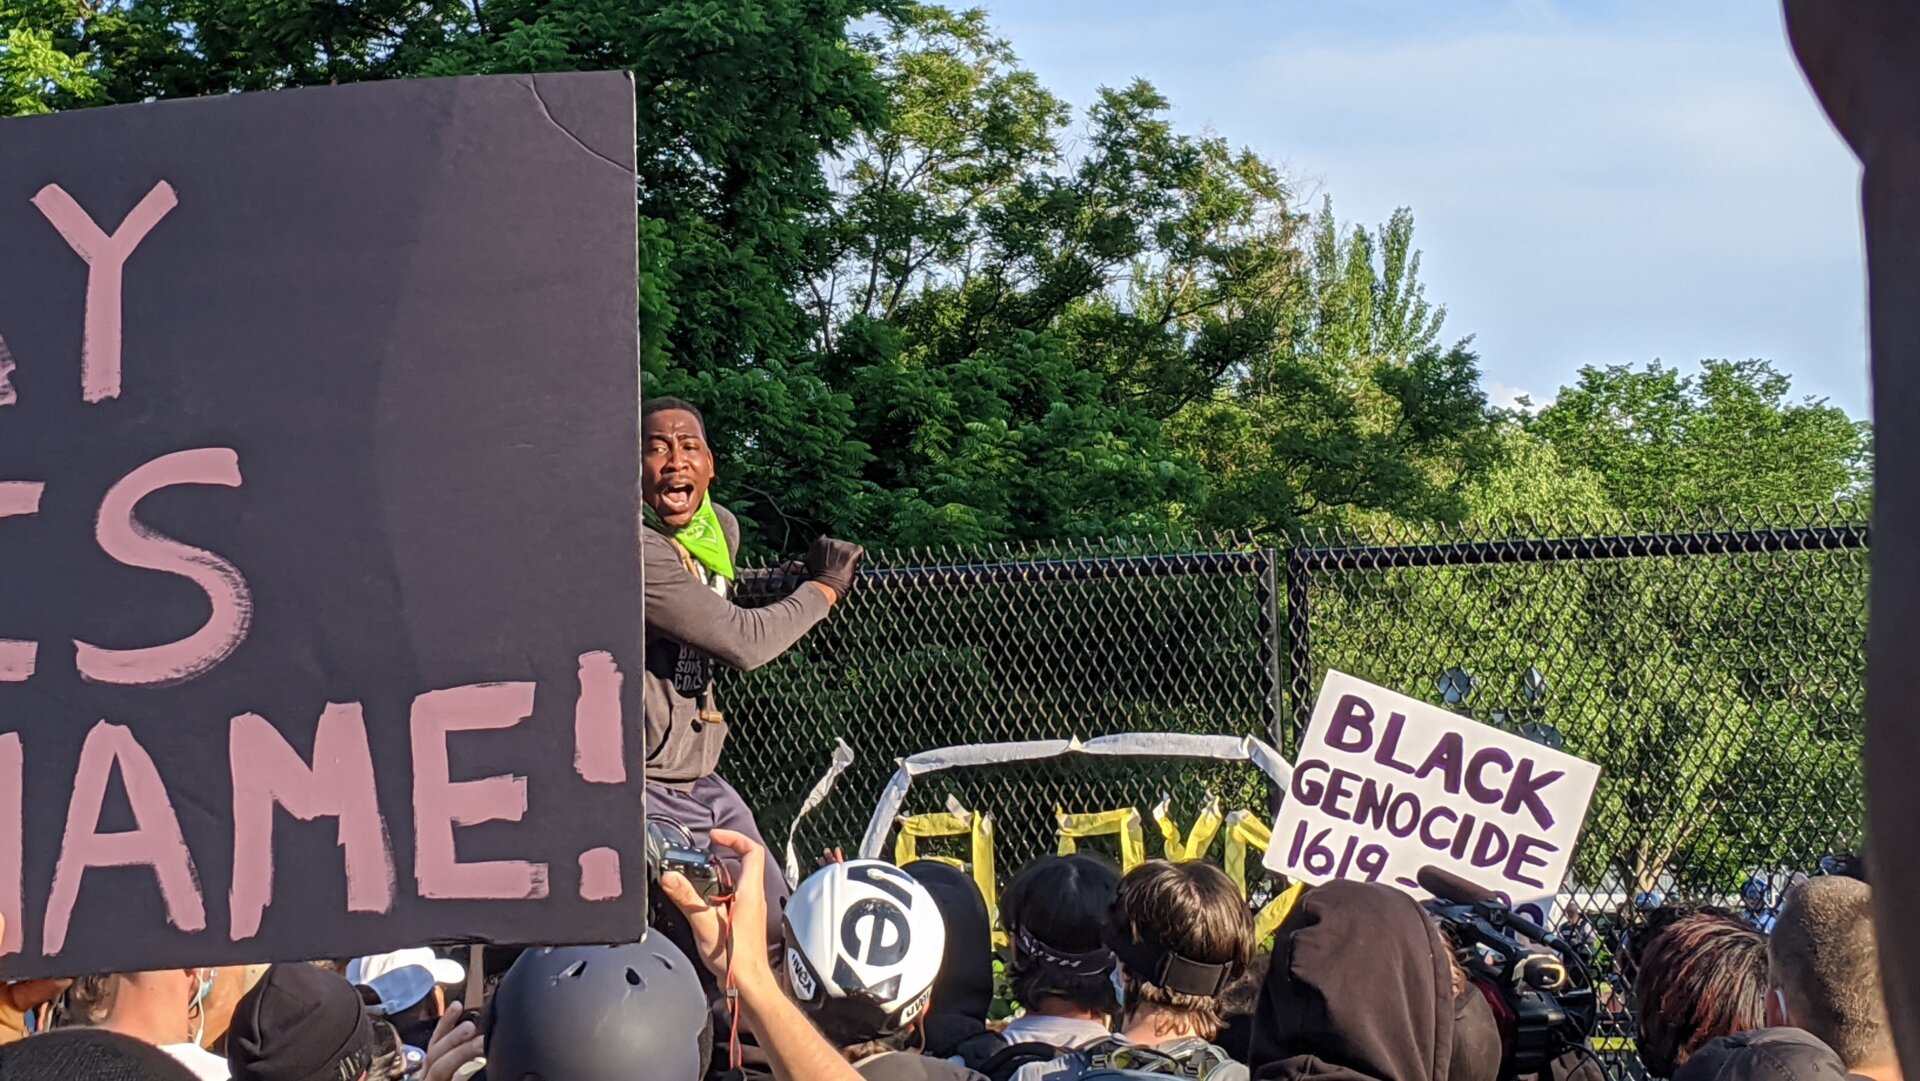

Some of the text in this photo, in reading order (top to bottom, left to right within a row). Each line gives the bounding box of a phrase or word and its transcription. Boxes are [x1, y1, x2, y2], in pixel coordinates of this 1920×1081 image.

[0, 181, 178, 407] Y
[0, 649, 626, 956] AME!
[1291, 759, 1559, 889] GENOCIDE
[1324, 694, 1565, 831] BLACK
